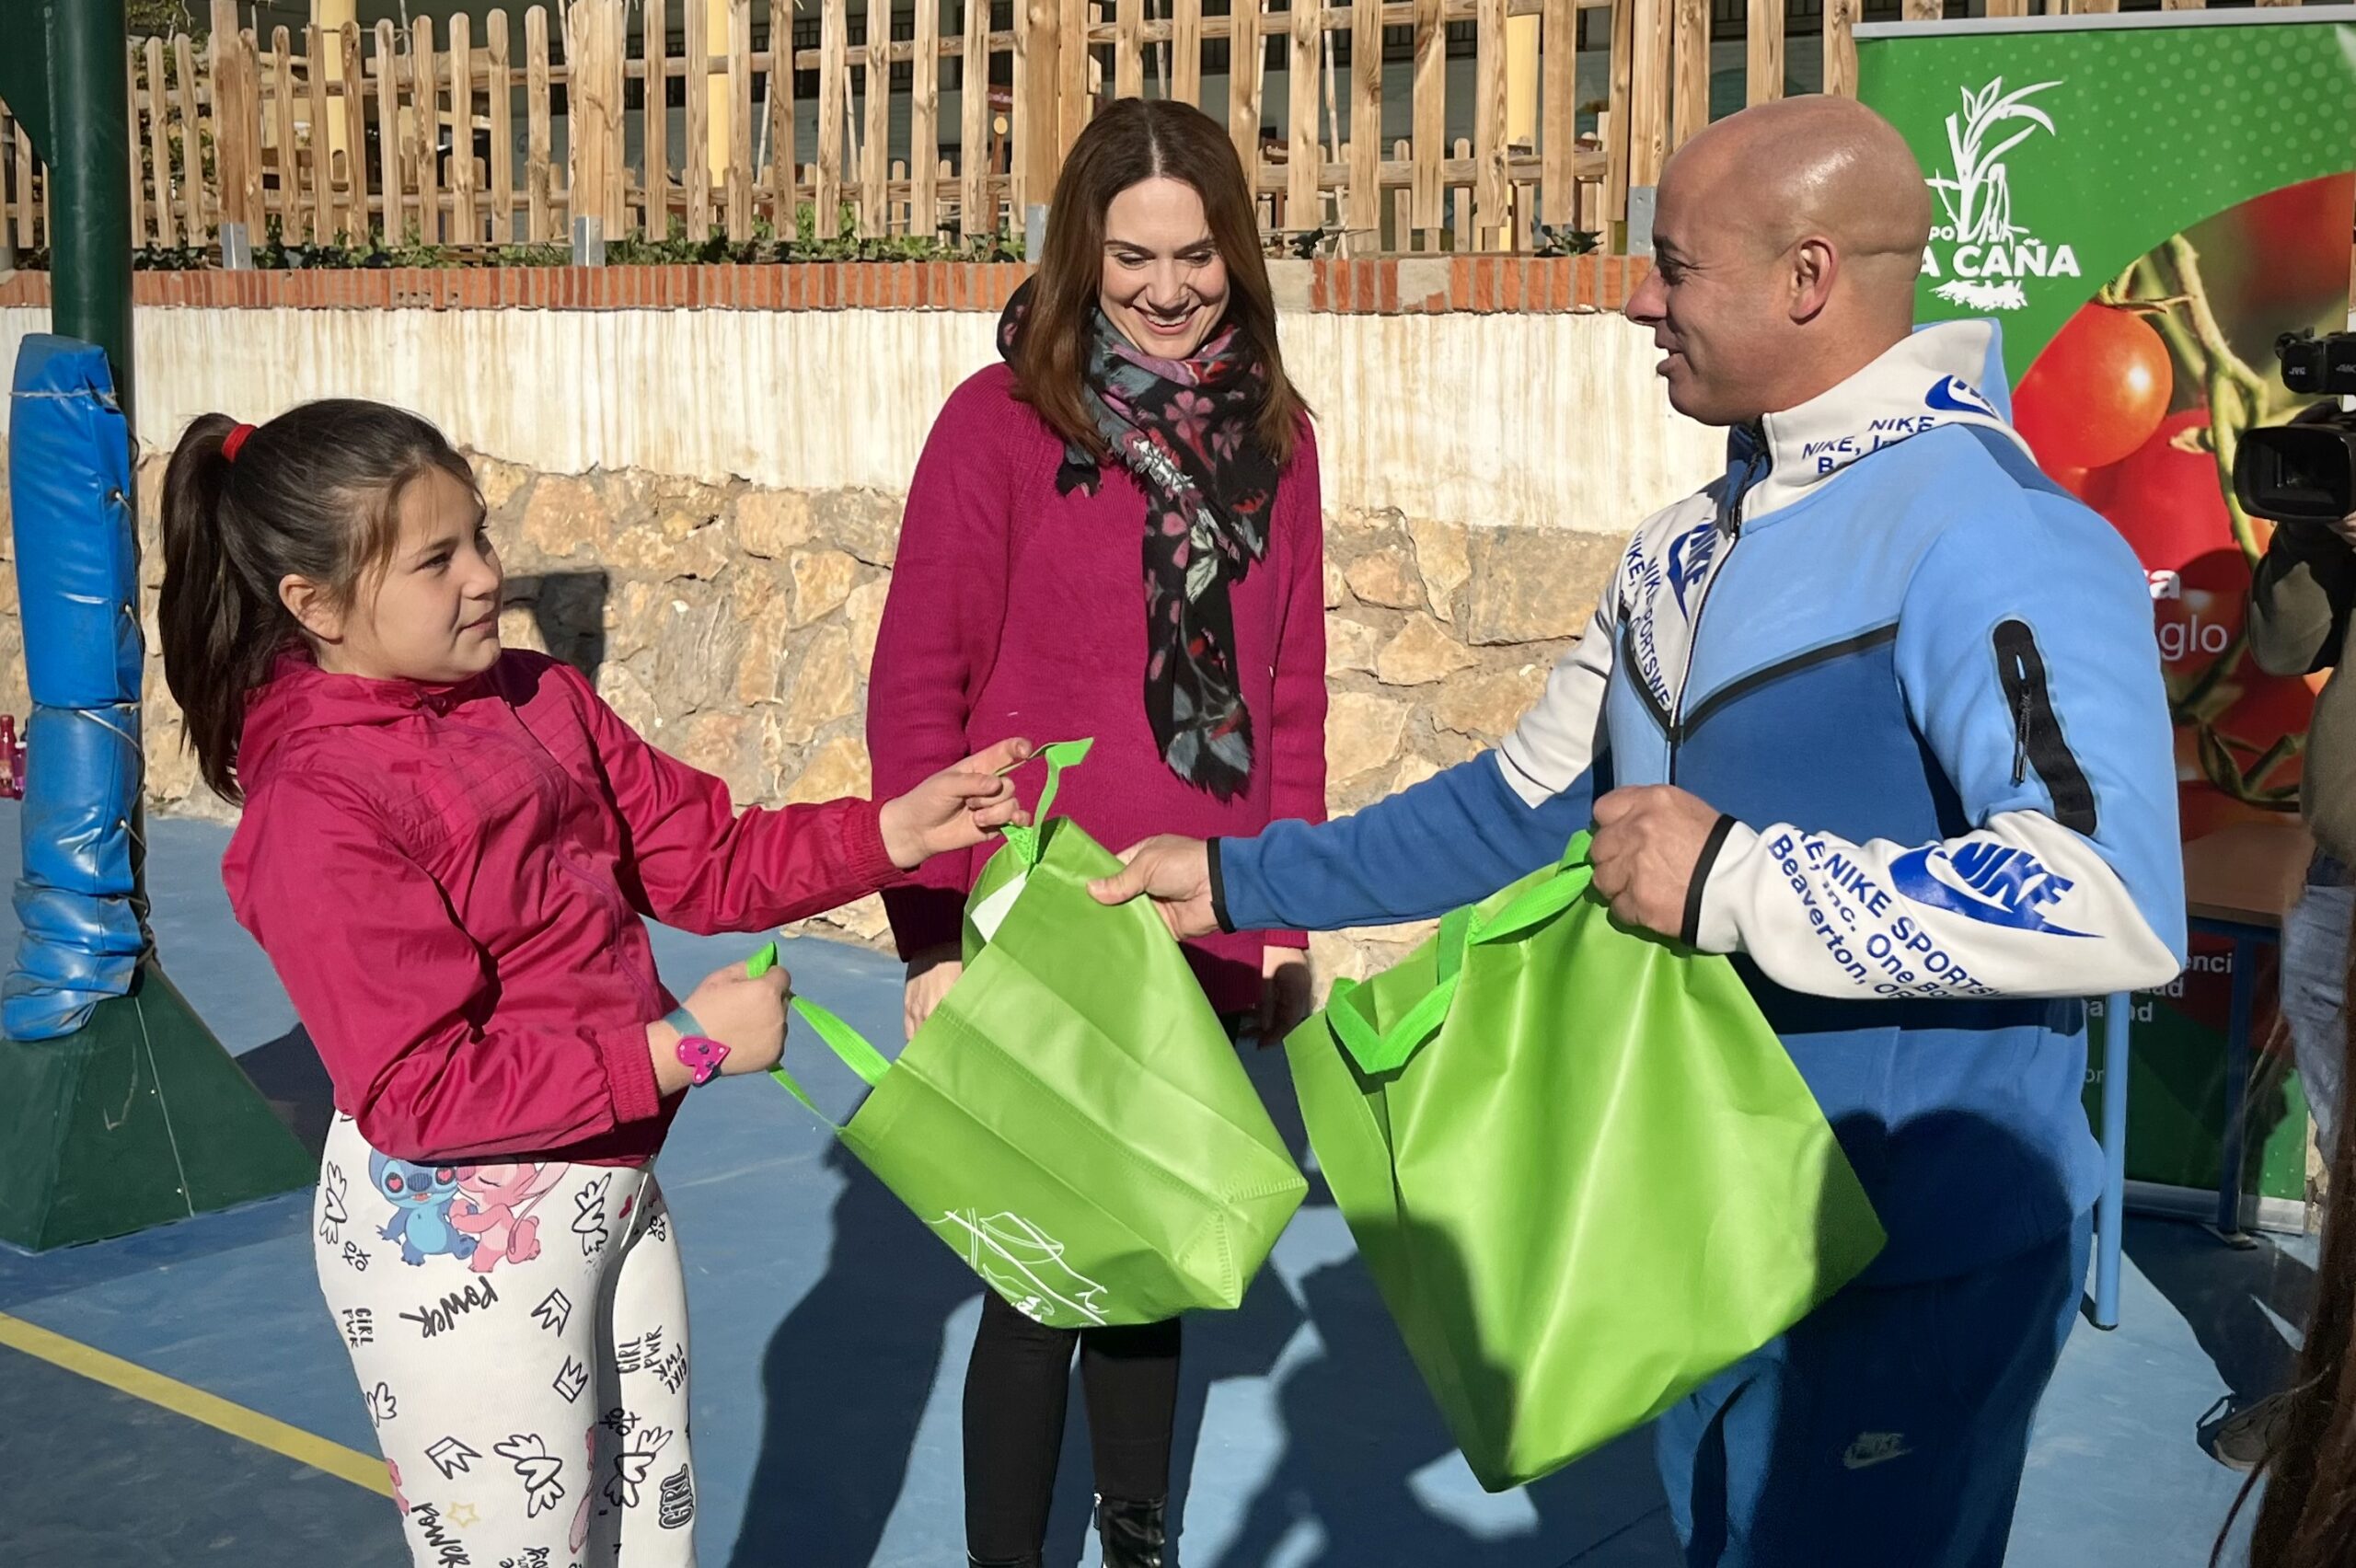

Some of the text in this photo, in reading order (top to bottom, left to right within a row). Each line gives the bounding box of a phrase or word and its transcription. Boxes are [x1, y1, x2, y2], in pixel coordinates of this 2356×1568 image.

[1928, 225, 1955, 241] PO
[1920, 237, 2081, 277] A CAÑA
[1803, 435, 1862, 459] NIKE,
[1868, 416, 1935, 434] NIKE
[2142, 570, 2180, 599] a
[2159, 615, 2228, 661] glo
[1936, 842, 2074, 918] NIKE
[1768, 833, 1867, 986] Beaverton,
[1824, 853, 1892, 918] NIKE
[1890, 917, 2005, 998] SPORTS
[1866, 933, 1915, 983] One
[643, 1325, 663, 1369] PWR
